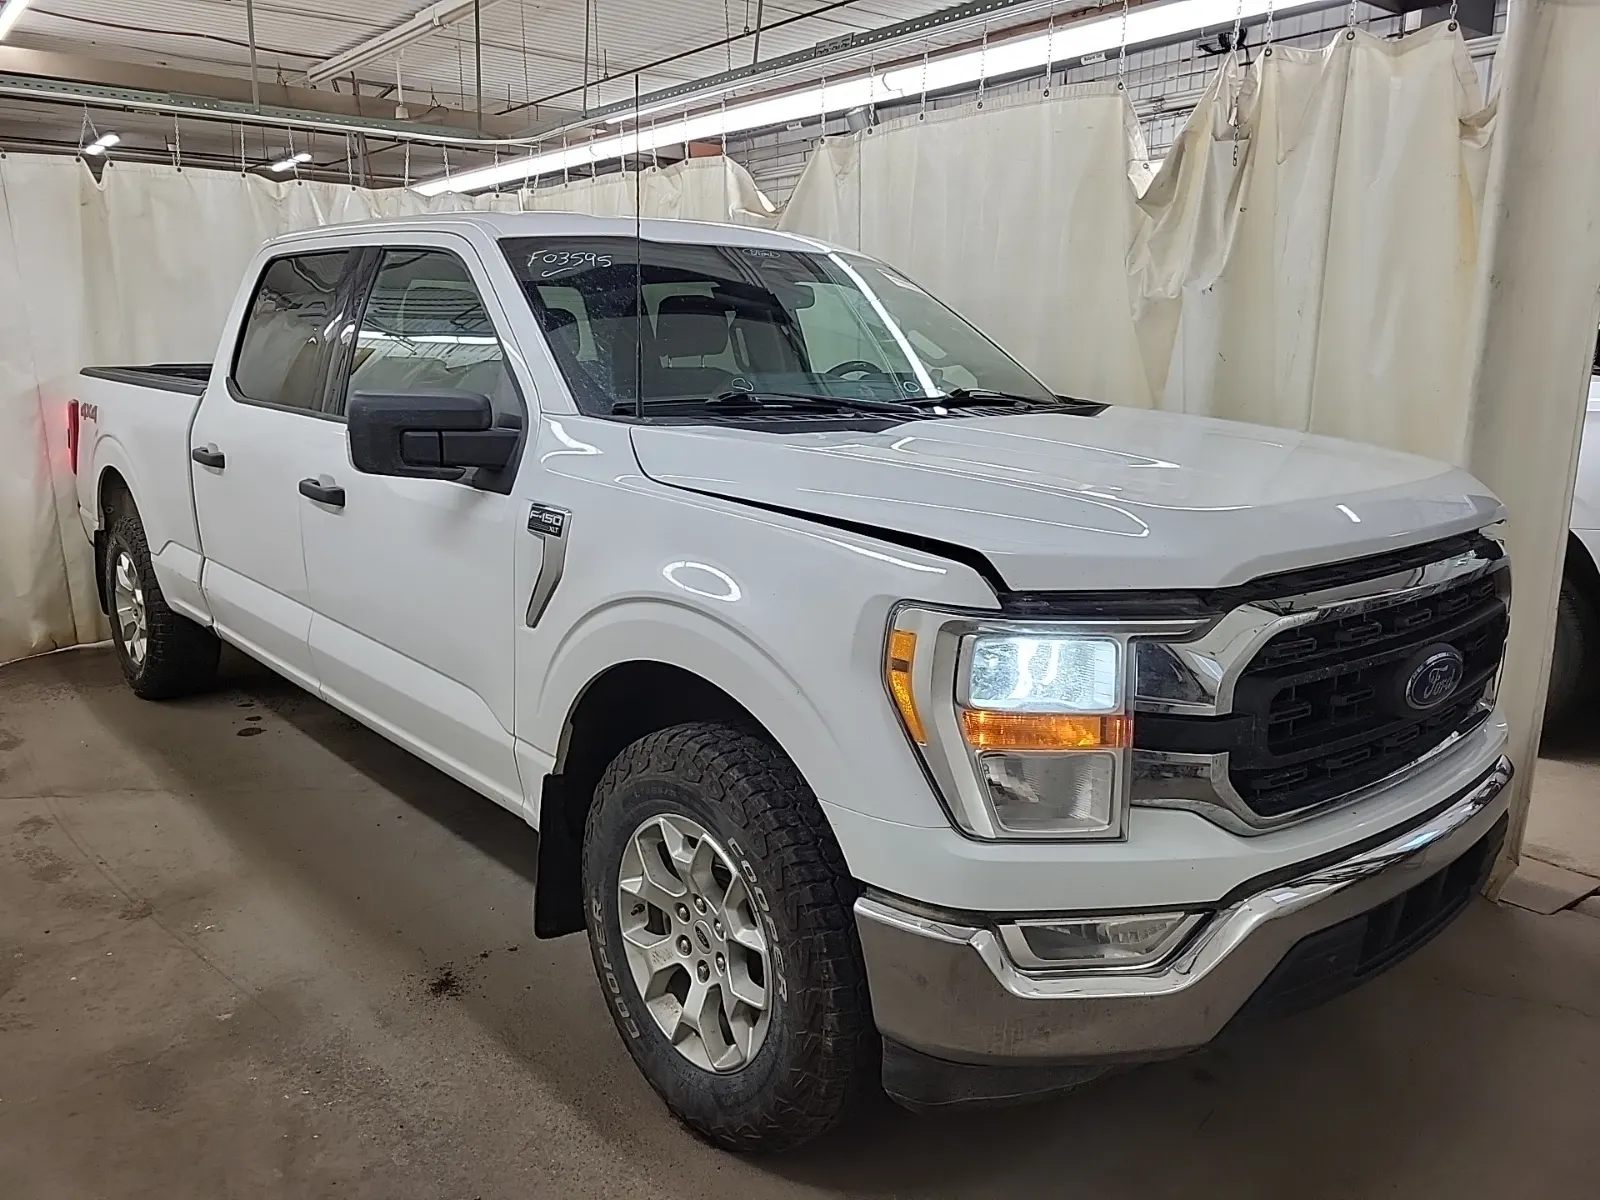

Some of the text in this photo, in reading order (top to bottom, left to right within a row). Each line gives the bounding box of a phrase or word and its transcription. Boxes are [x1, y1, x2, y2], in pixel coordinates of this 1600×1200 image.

[527, 249, 612, 267] F03595
[529, 509, 563, 526] F-150
[1423, 664, 1456, 699] Ford
[727, 837, 788, 1003] COOPER
[592, 897, 641, 1039] COOPER
